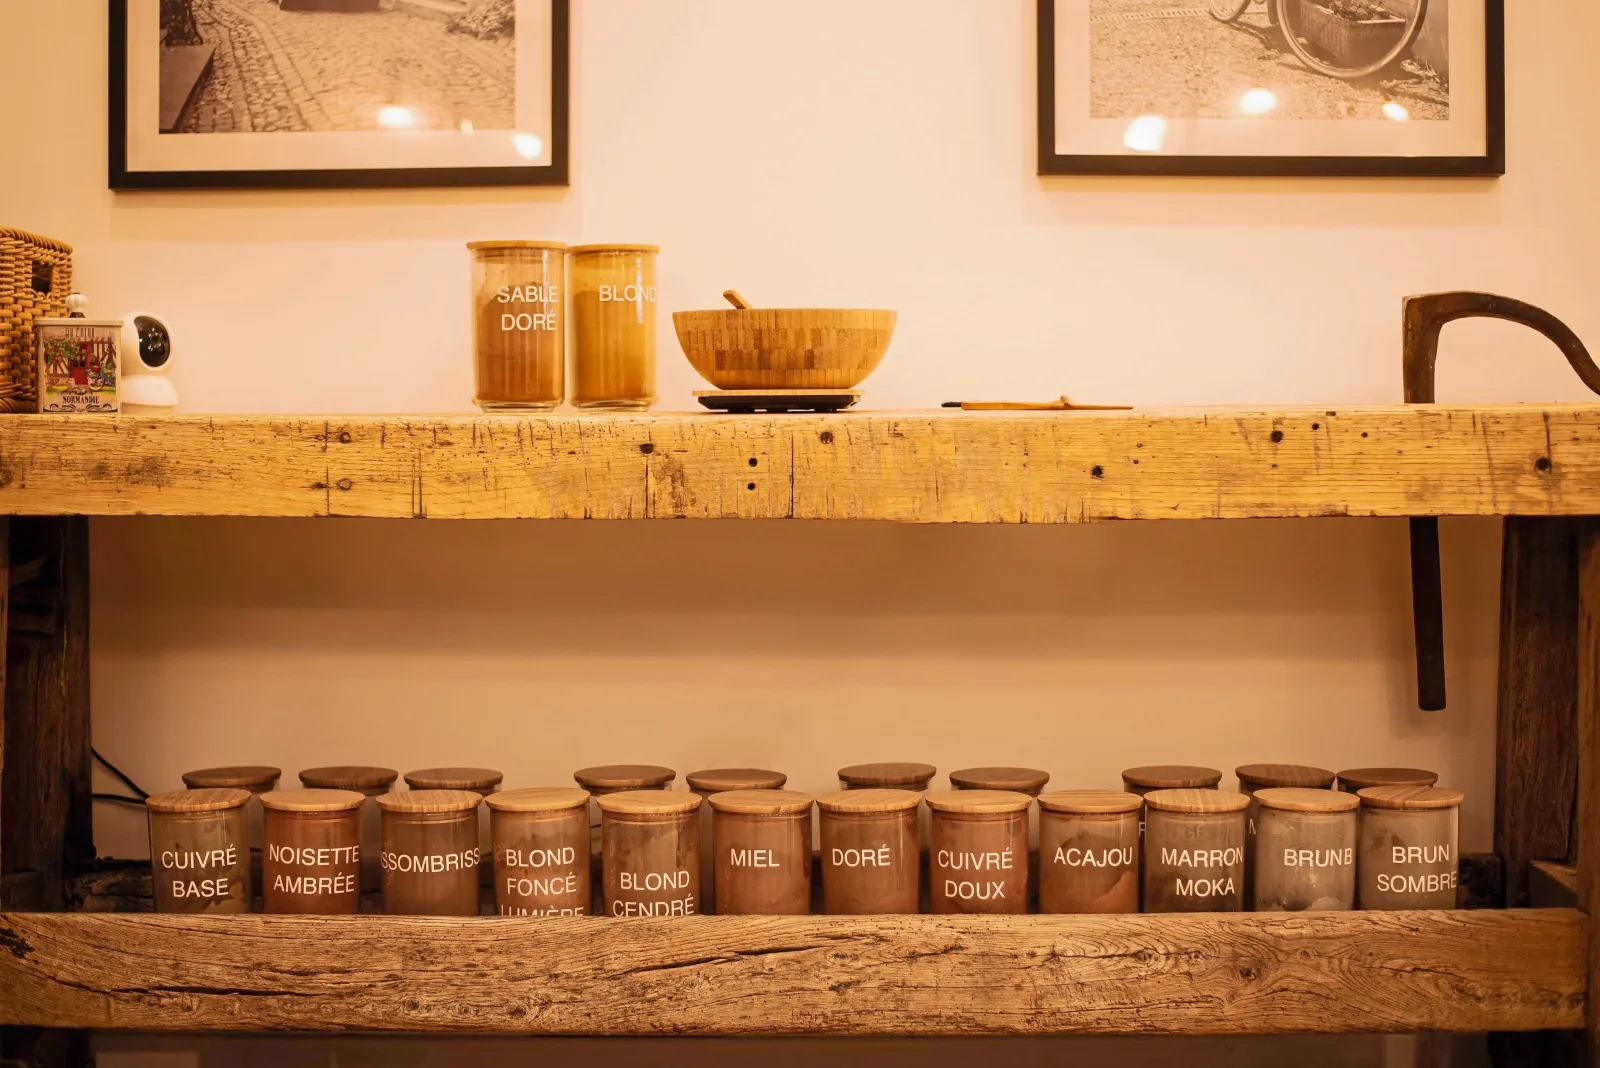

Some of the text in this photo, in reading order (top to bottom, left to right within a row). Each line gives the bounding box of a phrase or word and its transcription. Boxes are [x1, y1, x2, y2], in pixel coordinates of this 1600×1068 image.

[501, 309, 557, 331] DORÉ
[62, 395, 100, 404] NORMANDIE
[161, 843, 237, 869] CUIVRÉ
[269, 843, 360, 866] NOISETTE
[506, 846, 575, 867] BLOND
[730, 848, 780, 868] MIEL
[832, 843, 891, 867] DORÉ
[938, 847, 1013, 870] CUIVRÉ
[1053, 846, 1133, 868] ACAJOU
[1161, 845, 1244, 868] MARRON
[1392, 844, 1450, 864] BRUN
[172, 878, 229, 898] BASE
[273, 871, 355, 895] AMBRÉE
[507, 871, 577, 897] FONCÉ
[620, 870, 690, 891] BLOND
[945, 880, 1005, 899] DOUX
[1176, 877, 1235, 897] MOKA
[1377, 870, 1457, 893] SOMBRE
[613, 892, 695, 917] CENDRÉ
